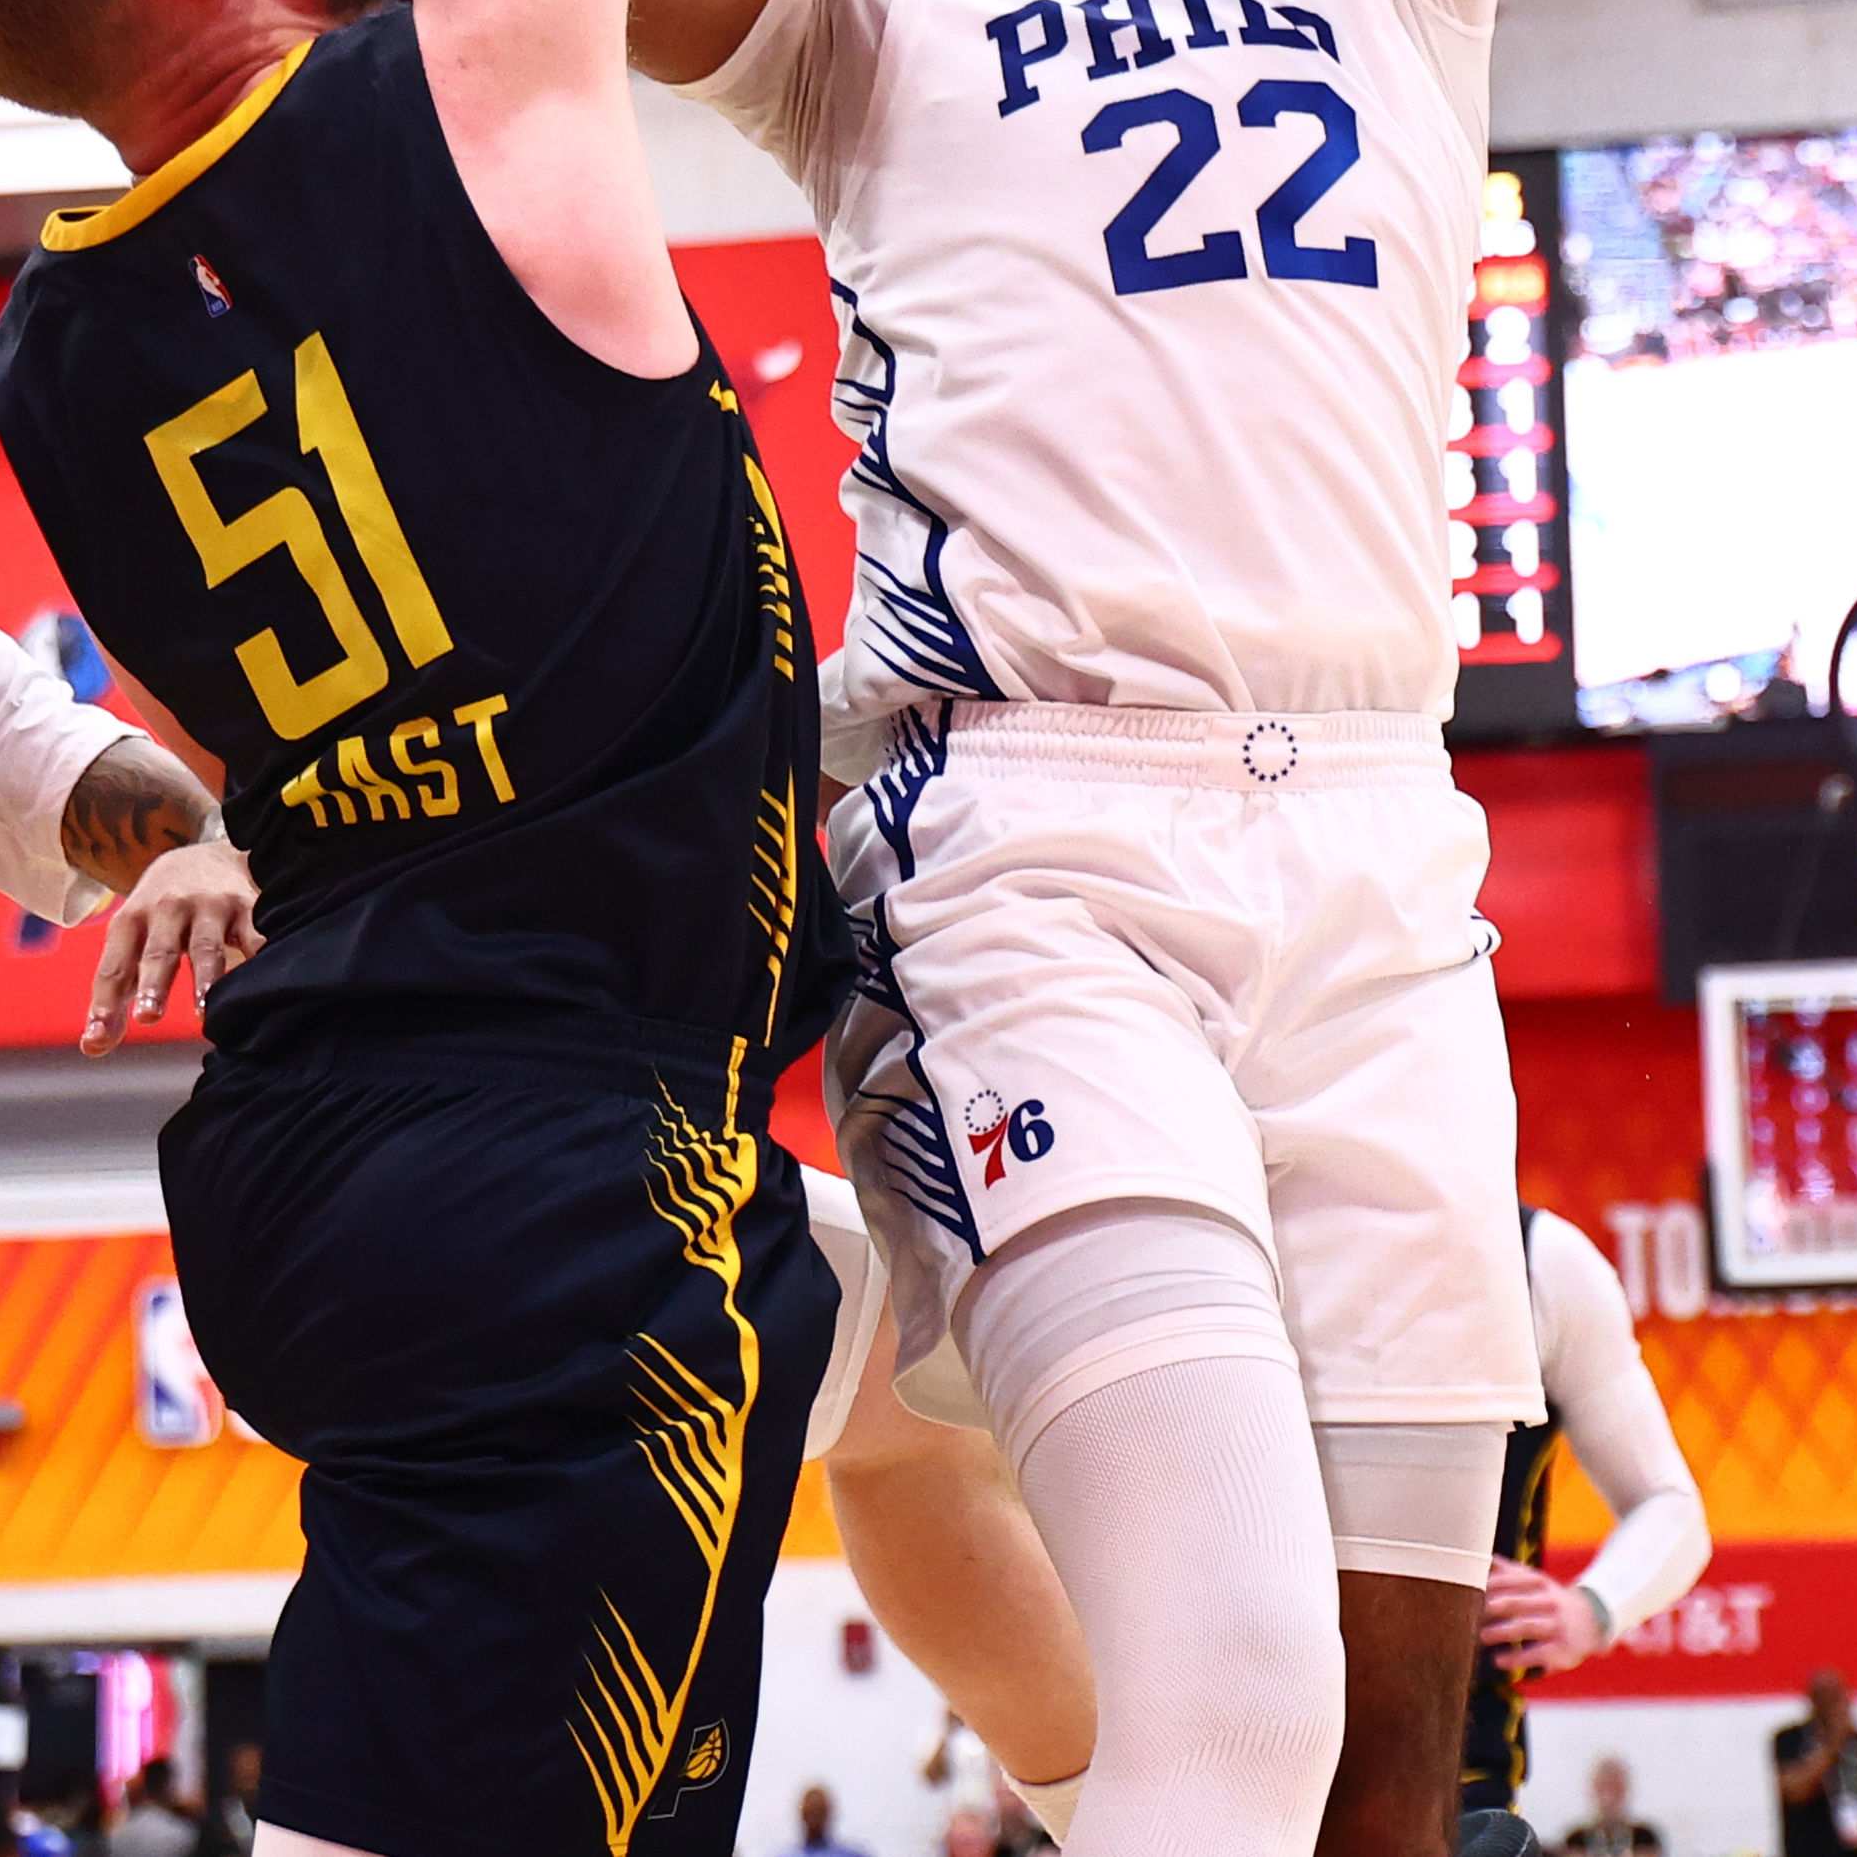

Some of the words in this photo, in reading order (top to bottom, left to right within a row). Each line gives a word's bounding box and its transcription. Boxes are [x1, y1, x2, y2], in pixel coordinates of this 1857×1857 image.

[1081, 79, 1379, 296] 22
[143, 330, 454, 740] 51
[967, 1099, 1055, 1190] 76
